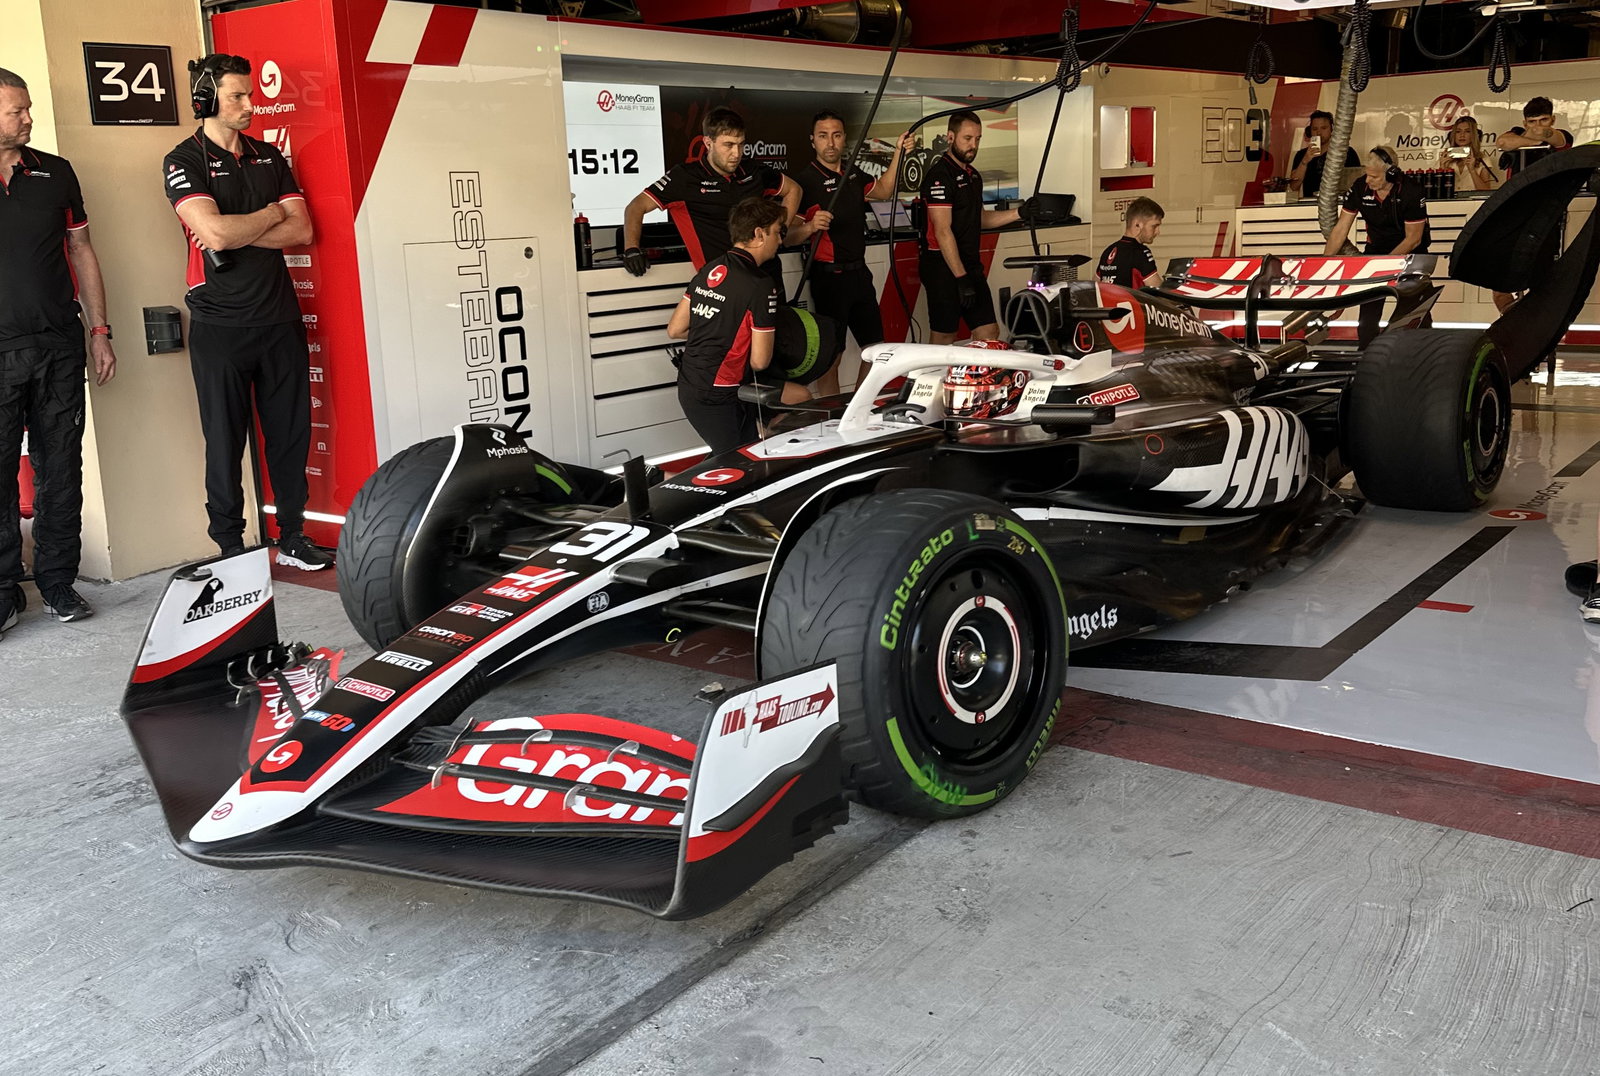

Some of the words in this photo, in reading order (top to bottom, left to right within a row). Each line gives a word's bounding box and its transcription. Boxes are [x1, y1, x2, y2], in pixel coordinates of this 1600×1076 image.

[95, 61, 166, 102] 34
[615, 93, 655, 104] MoneyGram
[253, 102, 296, 116] MoneyGram
[1397, 131, 1497, 150] Moneym
[567, 149, 639, 175] 15:12
[695, 286, 726, 302] MoneyGram
[692, 303, 720, 319] HAAS
[1145, 303, 1213, 339] MoneyGram
[916, 383, 933, 392] Palm
[1094, 386, 1137, 406] CHIPOTLE
[486, 445, 529, 459] Mphasis
[660, 483, 727, 496] MoneyGram
[549, 521, 650, 563] 31
[486, 586, 540, 599] HAAS
[880, 527, 955, 650] Cinturato
[184, 589, 262, 623] OAKBERRY
[1067, 604, 1119, 640] ngels
[375, 650, 433, 672] PIRELLI
[347, 680, 392, 700] CHIPOTLE
